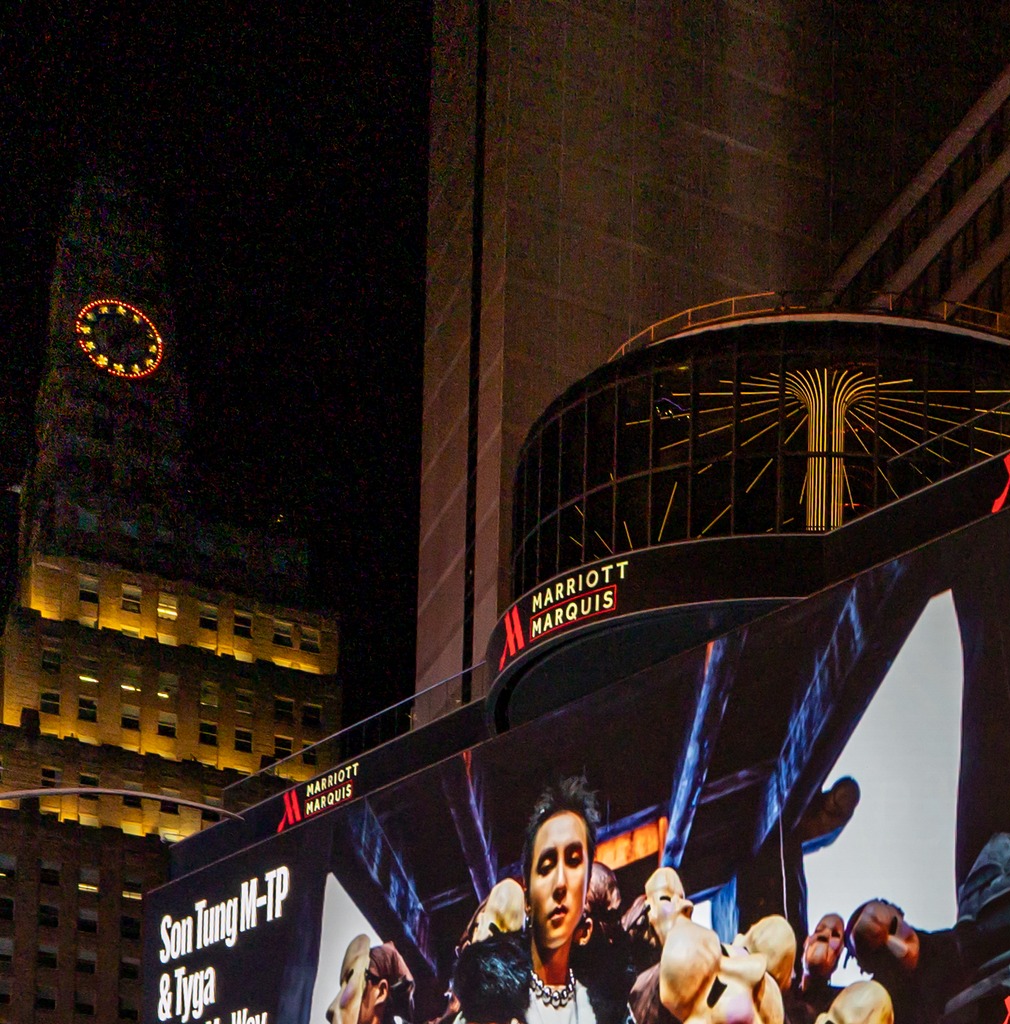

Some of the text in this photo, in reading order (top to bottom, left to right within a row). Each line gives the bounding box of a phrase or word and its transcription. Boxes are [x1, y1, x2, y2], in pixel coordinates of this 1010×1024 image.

[532, 561, 629, 613] MARRIOTT
[532, 591, 614, 638] MARQUIS
[306, 762, 359, 797] MARRIOTT
[306, 783, 352, 815] MARQUIS
[159, 914, 193, 964] Son
[195, 897, 239, 948] Tung
[157, 966, 216, 1023] & Tyga
